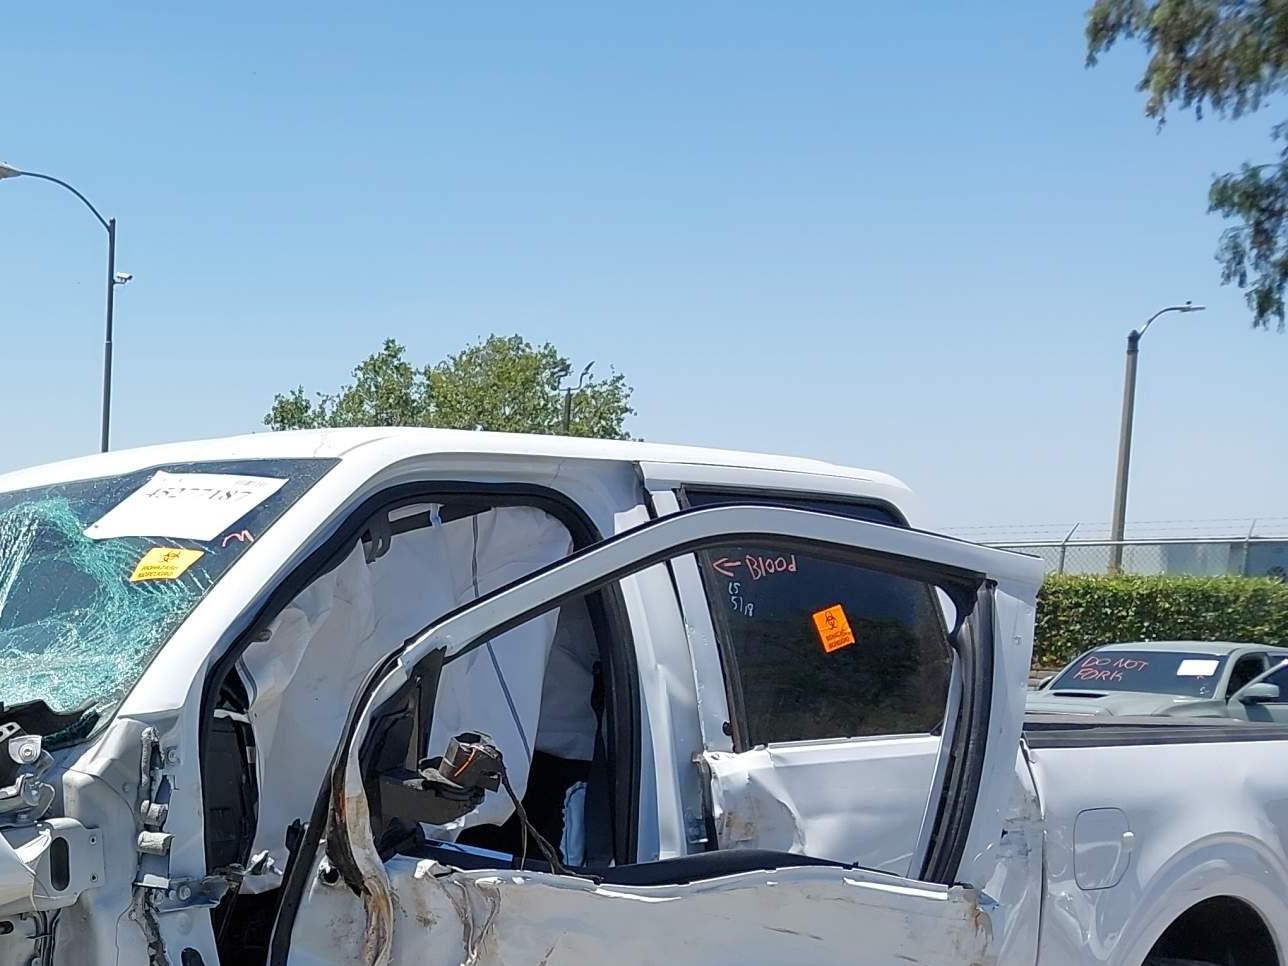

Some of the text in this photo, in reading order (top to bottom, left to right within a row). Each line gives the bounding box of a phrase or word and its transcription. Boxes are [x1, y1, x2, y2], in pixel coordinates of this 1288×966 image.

[745, 554, 797, 580] Blood
[1081, 656, 1149, 672] DO NOT
